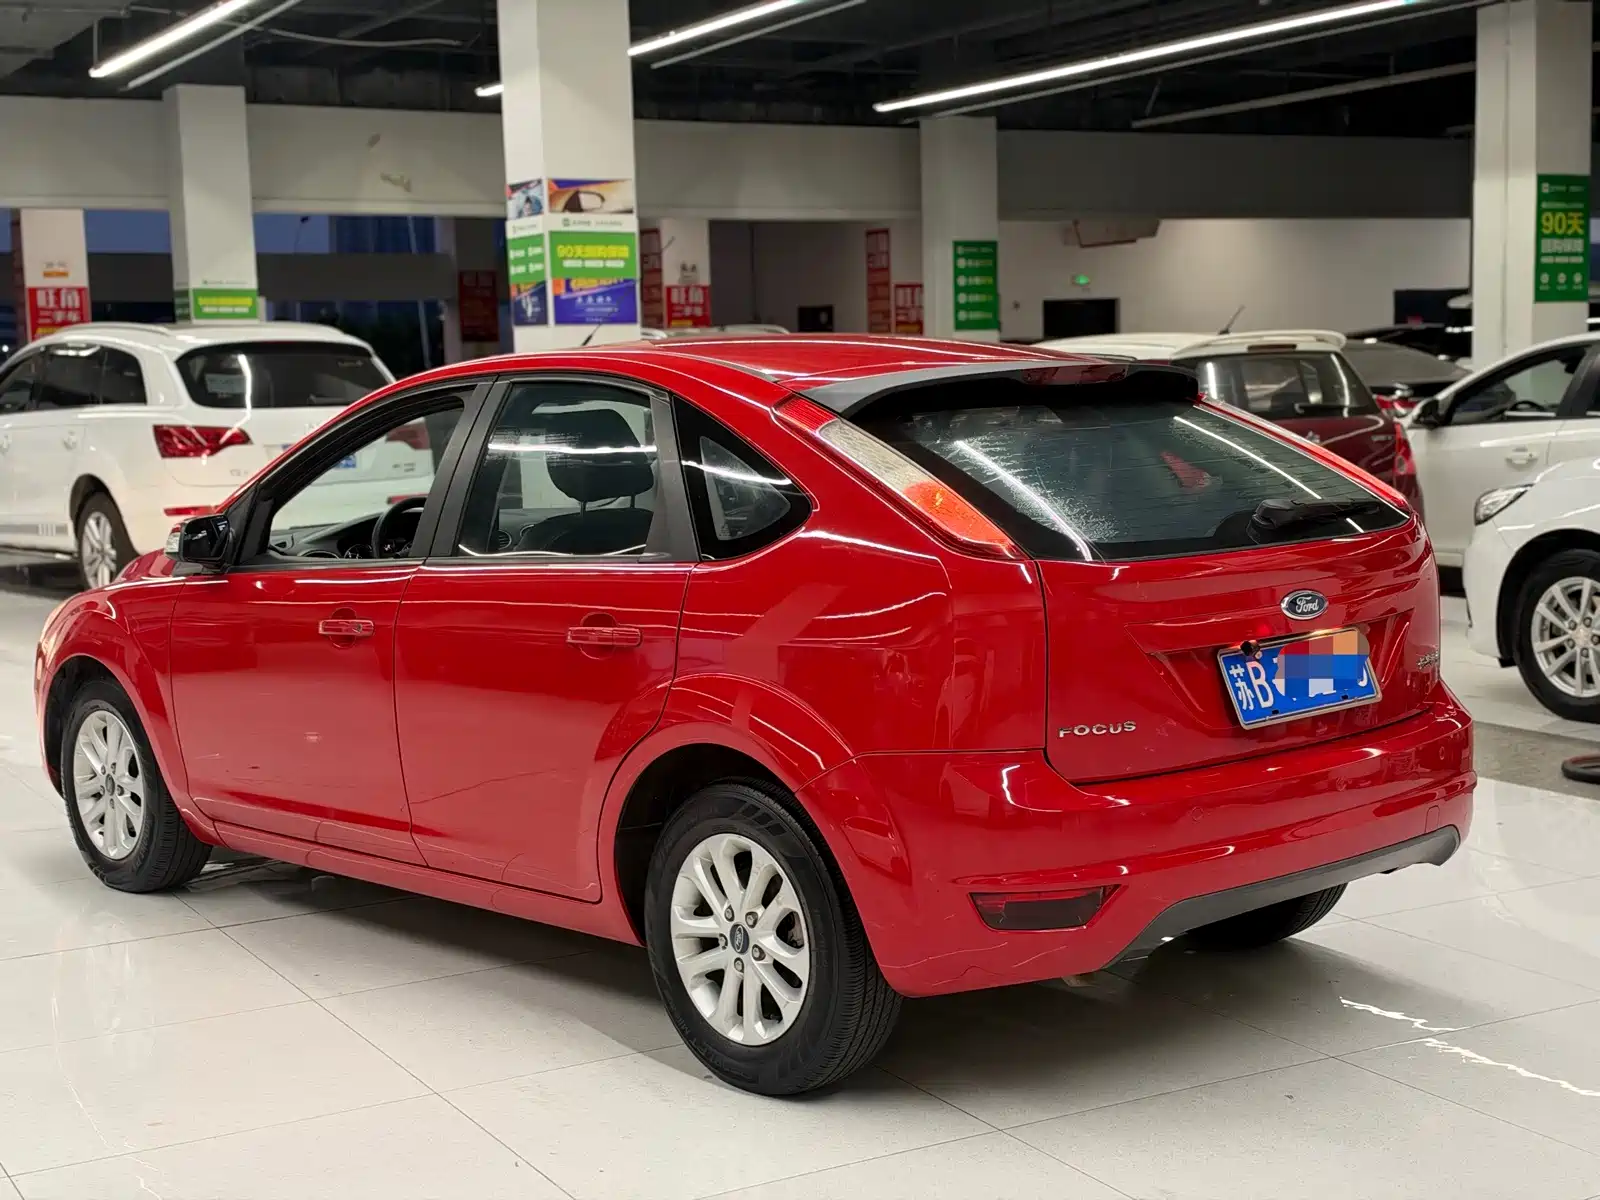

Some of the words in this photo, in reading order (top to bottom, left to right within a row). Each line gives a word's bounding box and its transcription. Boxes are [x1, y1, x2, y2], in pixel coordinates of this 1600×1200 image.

[1541, 211, 1585, 235] 90天
[1296, 596, 1319, 613] Ford
[1059, 720, 1137, 738] FOCUS
